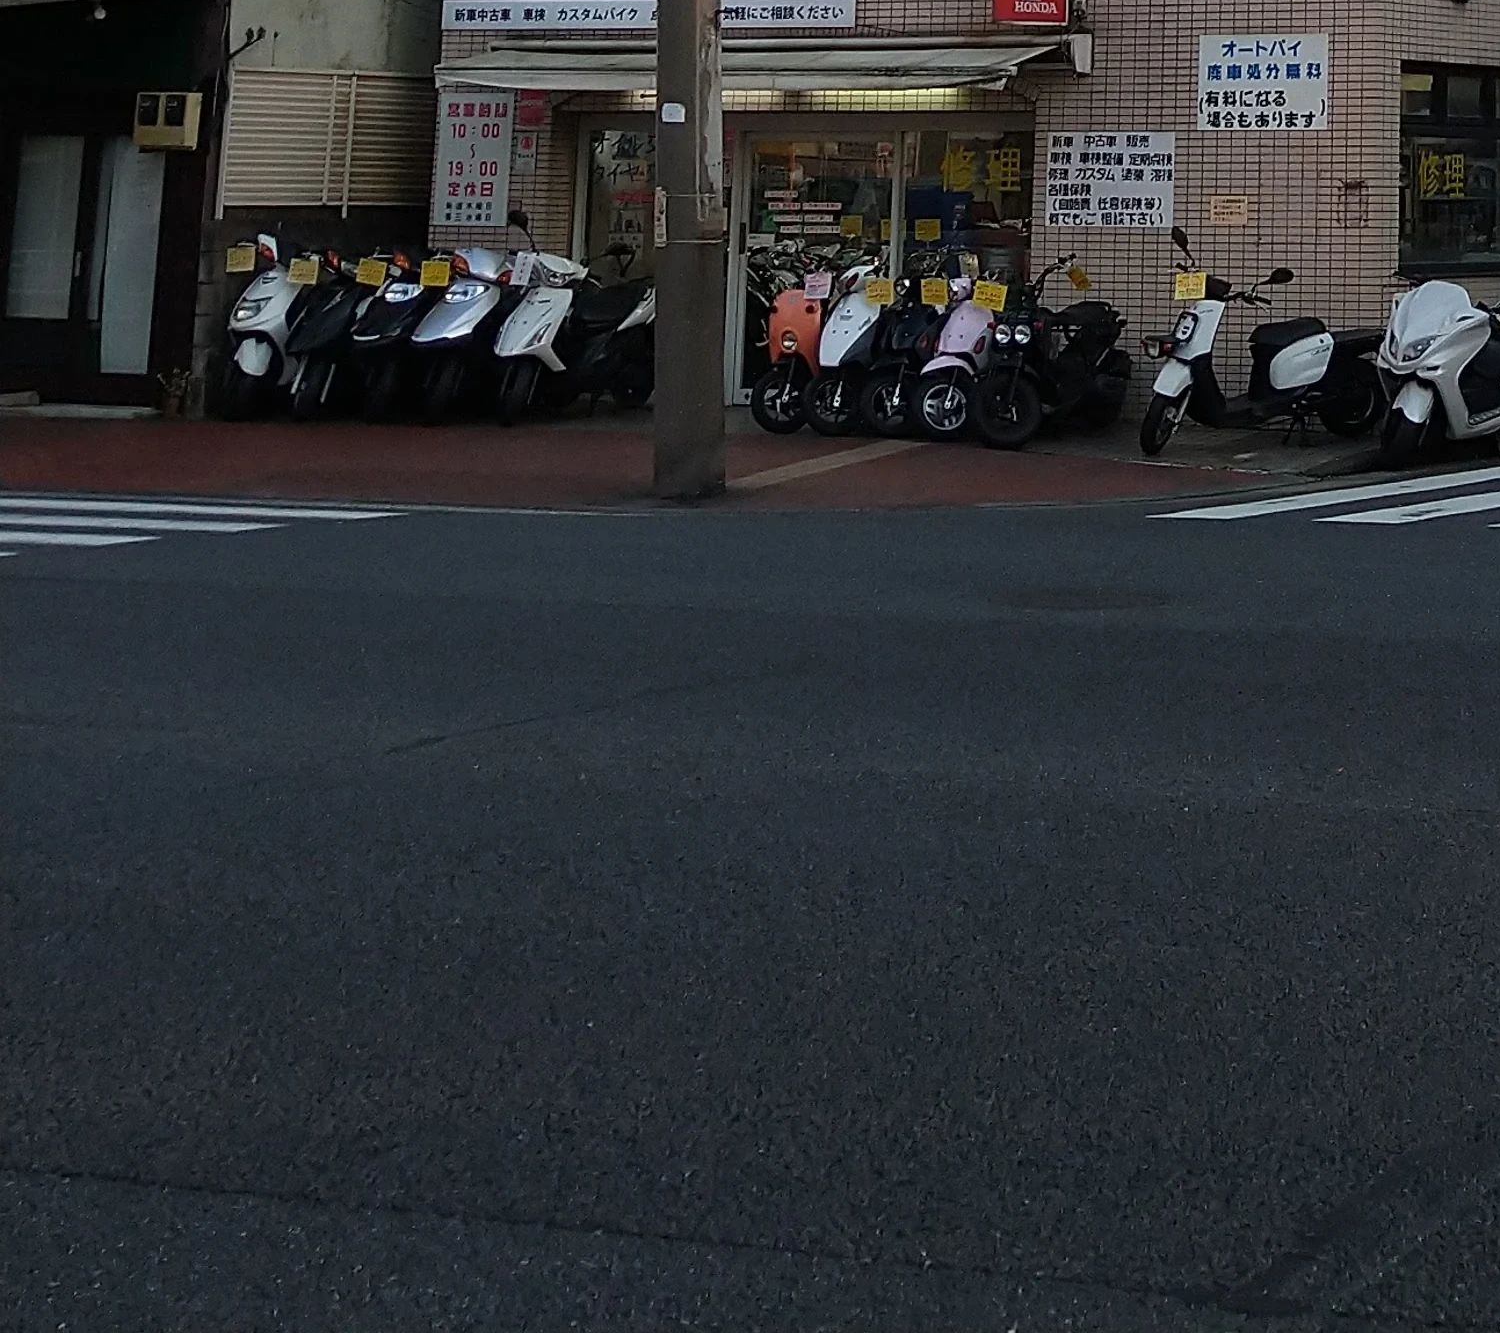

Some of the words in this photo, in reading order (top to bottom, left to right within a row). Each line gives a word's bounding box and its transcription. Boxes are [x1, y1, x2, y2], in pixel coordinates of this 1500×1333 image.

[454, 8, 511, 22] 新車中古車
[522, 8, 545, 22] 車検
[557, 7, 638, 22] カスタムバイク
[1014, 0, 1058, 15] HONDA
[1221, 38, 1301, 58] オートバイ
[1083, 134, 1117, 148] 中古車
[1075, 167, 1116, 181] カスタム
[1418, 149, 1465, 199] 修理
[447, 181, 494, 197] 定休日
